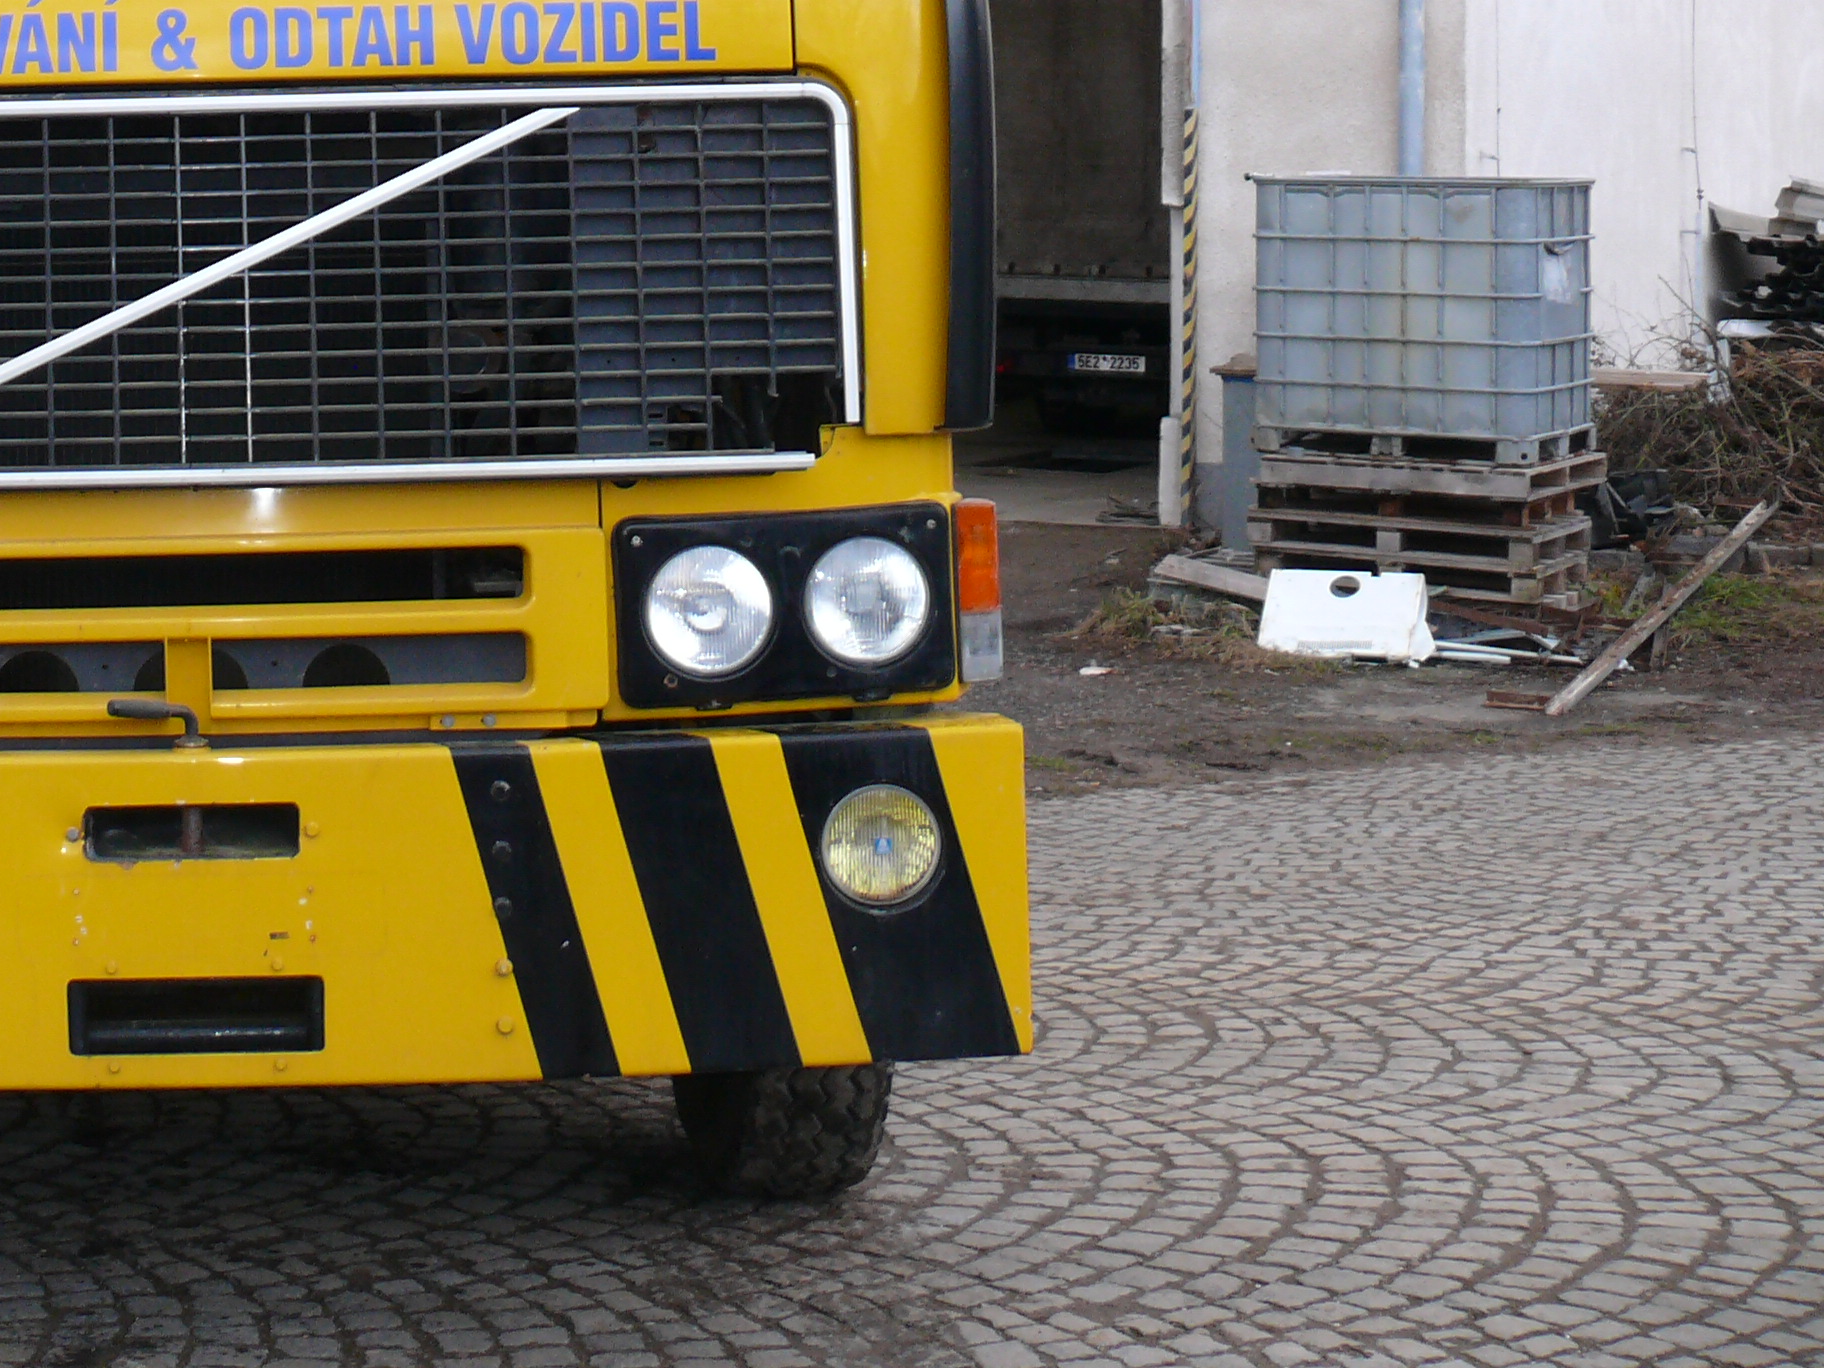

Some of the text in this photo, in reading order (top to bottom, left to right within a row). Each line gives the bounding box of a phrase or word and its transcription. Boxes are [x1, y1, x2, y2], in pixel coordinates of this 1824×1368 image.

[150, 8, 199, 72] &
[229, 4, 436, 71] ODTAH
[454, 0, 717, 66] VOZIDEL
